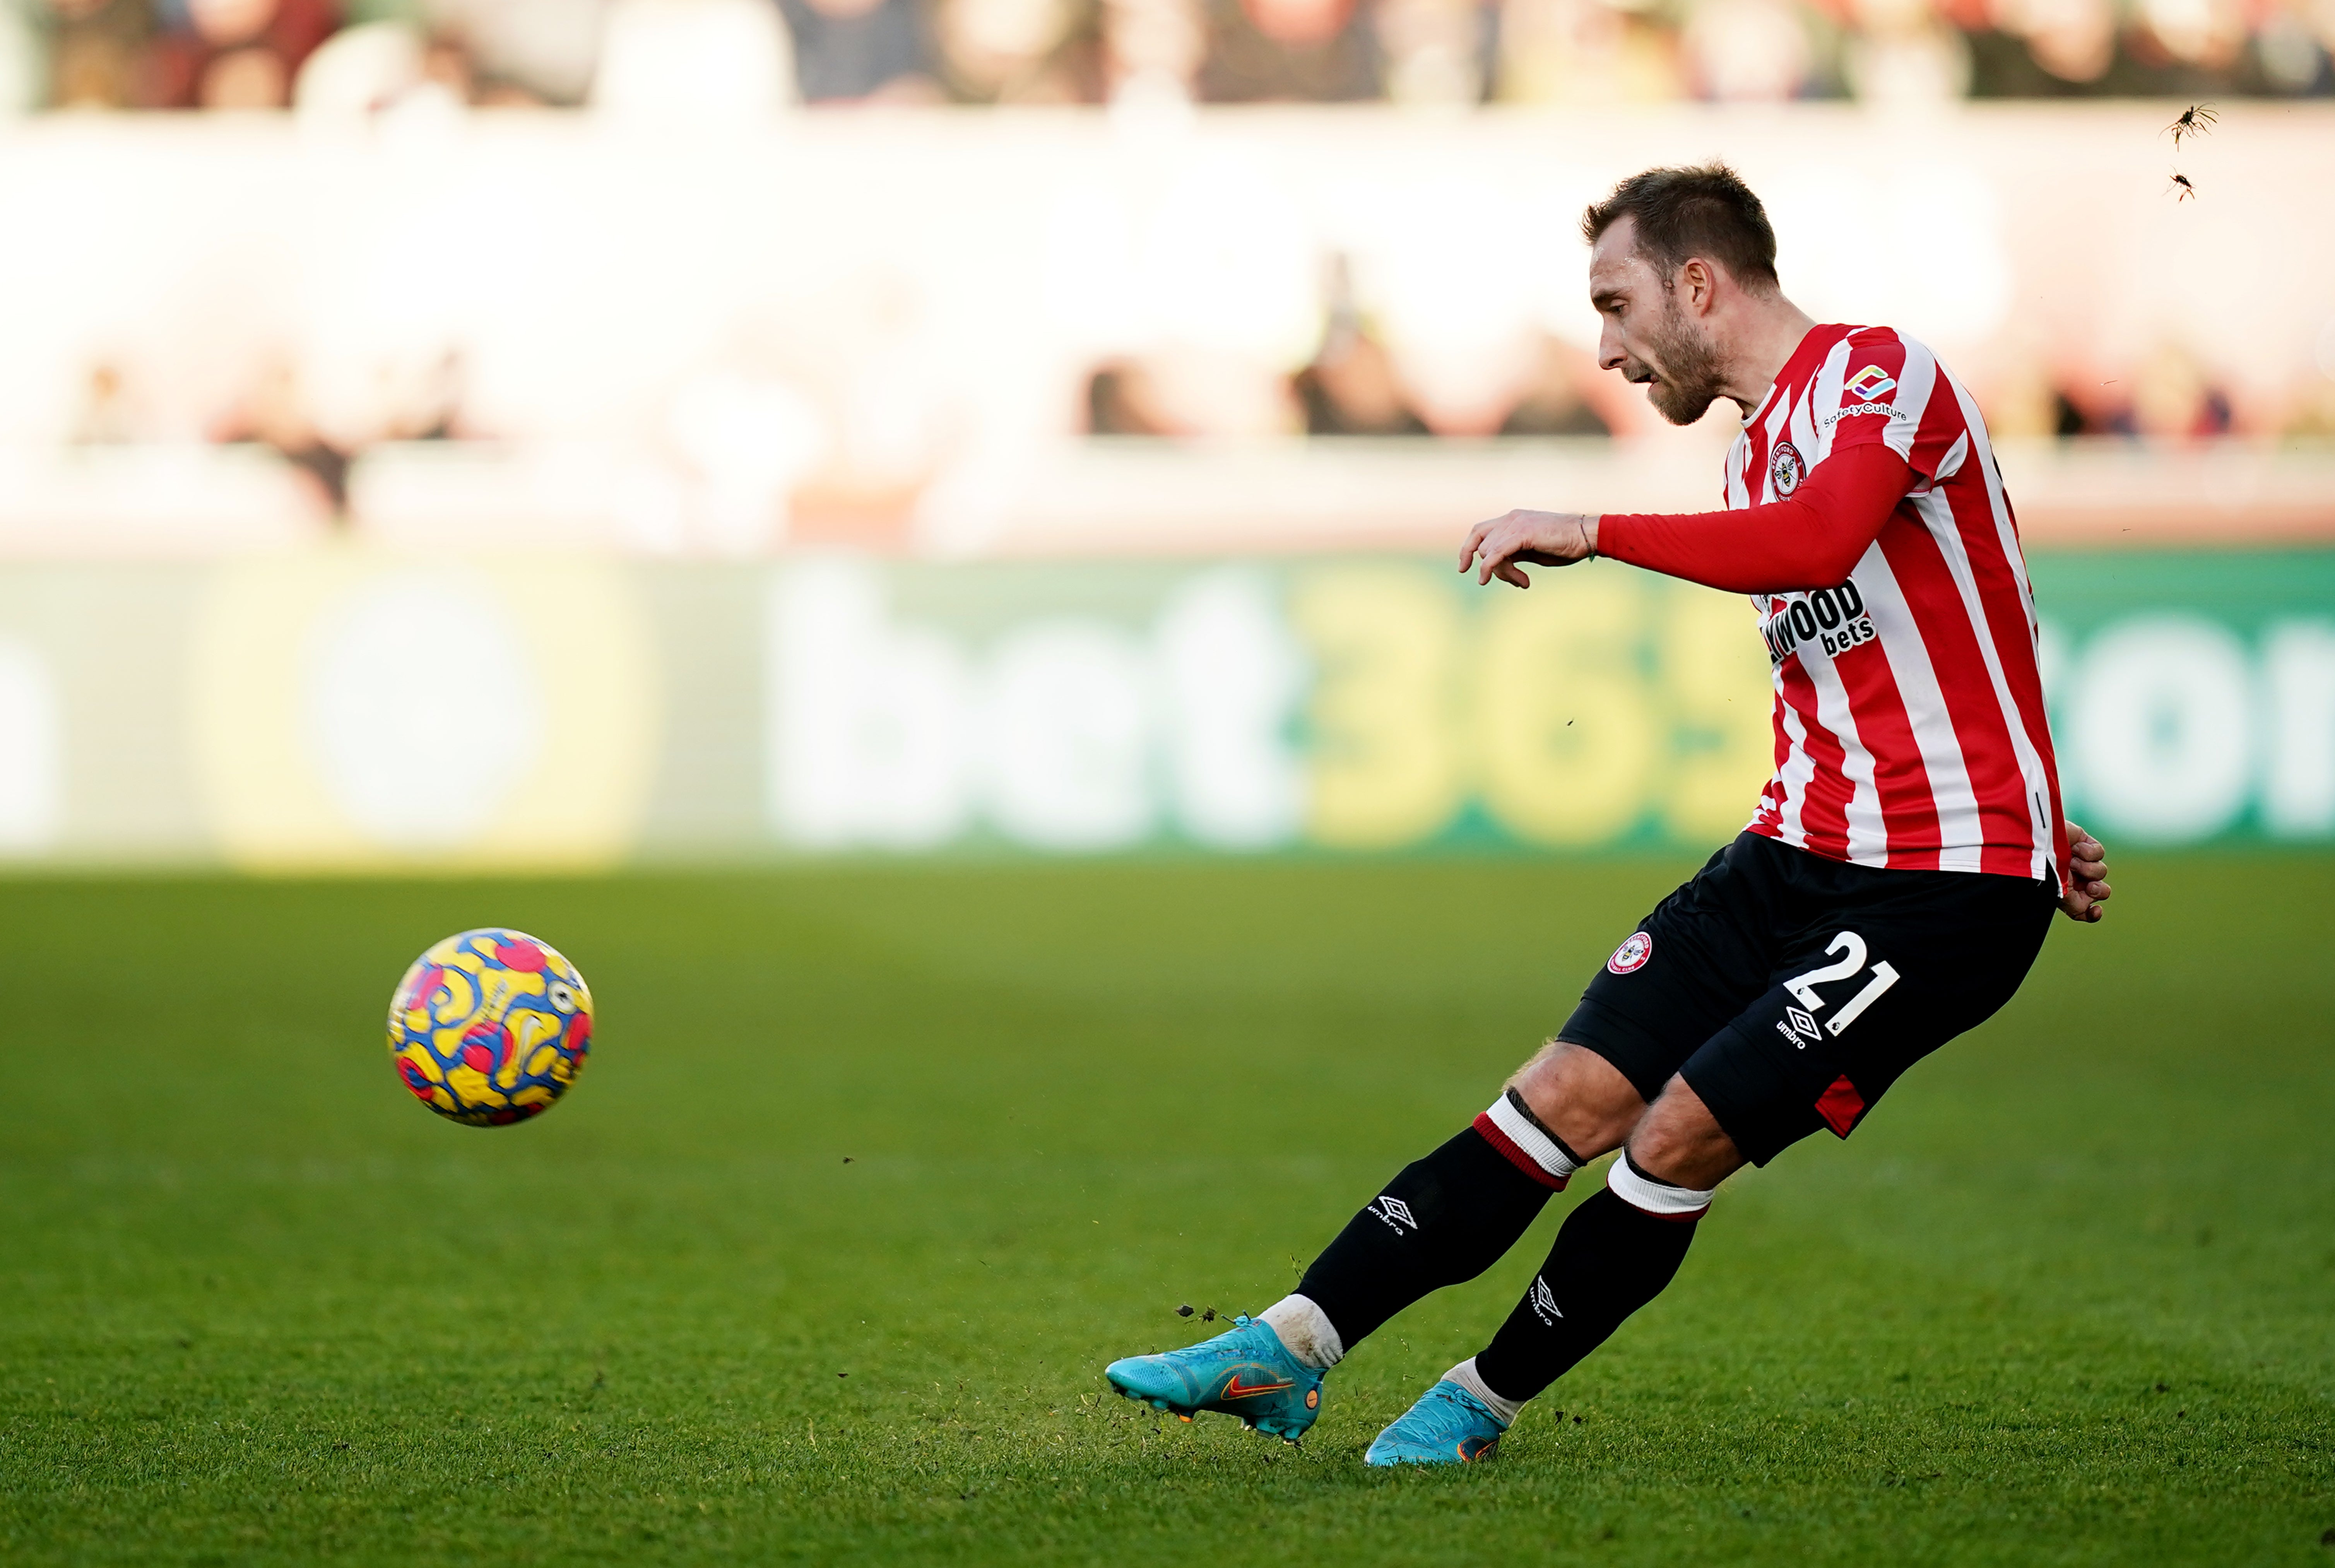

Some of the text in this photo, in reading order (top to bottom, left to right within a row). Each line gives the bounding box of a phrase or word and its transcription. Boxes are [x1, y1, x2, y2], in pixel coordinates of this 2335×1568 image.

[1824, 403, 1907, 428] SafetyCulture
[1772, 446, 1794, 470] BRENTFORD
[1820, 620, 1875, 657] bets
[1783, 931, 1901, 1037] 21
[1776, 1021, 1806, 1050] umbro
[1367, 1206, 1404, 1236] umbro
[1530, 1287, 1552, 1326] umbro
